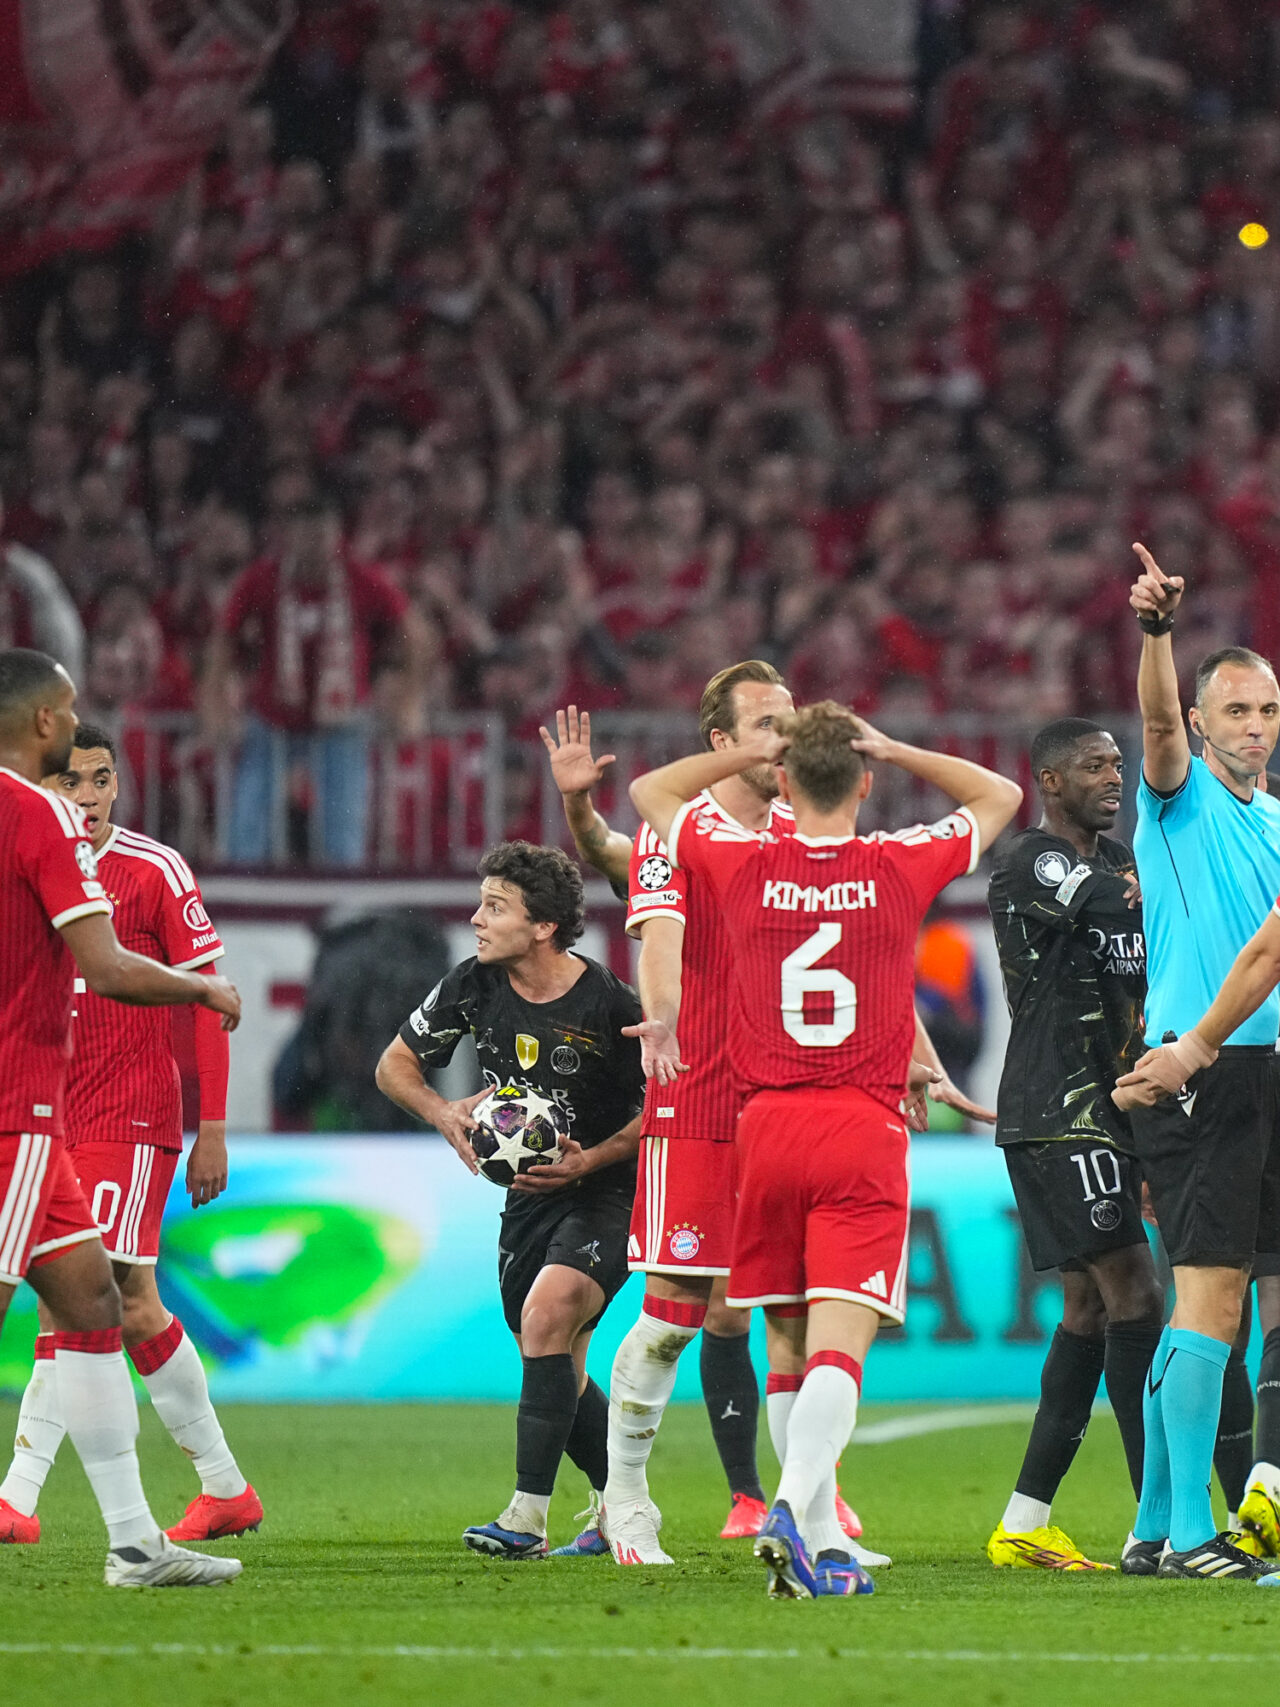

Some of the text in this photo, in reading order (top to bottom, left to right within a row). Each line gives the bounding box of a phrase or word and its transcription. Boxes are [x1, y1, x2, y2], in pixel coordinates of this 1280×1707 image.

[762, 880, 877, 912] KIMMICH
[780, 922, 857, 1047] 6
[1070, 1149, 1122, 1202] 10
